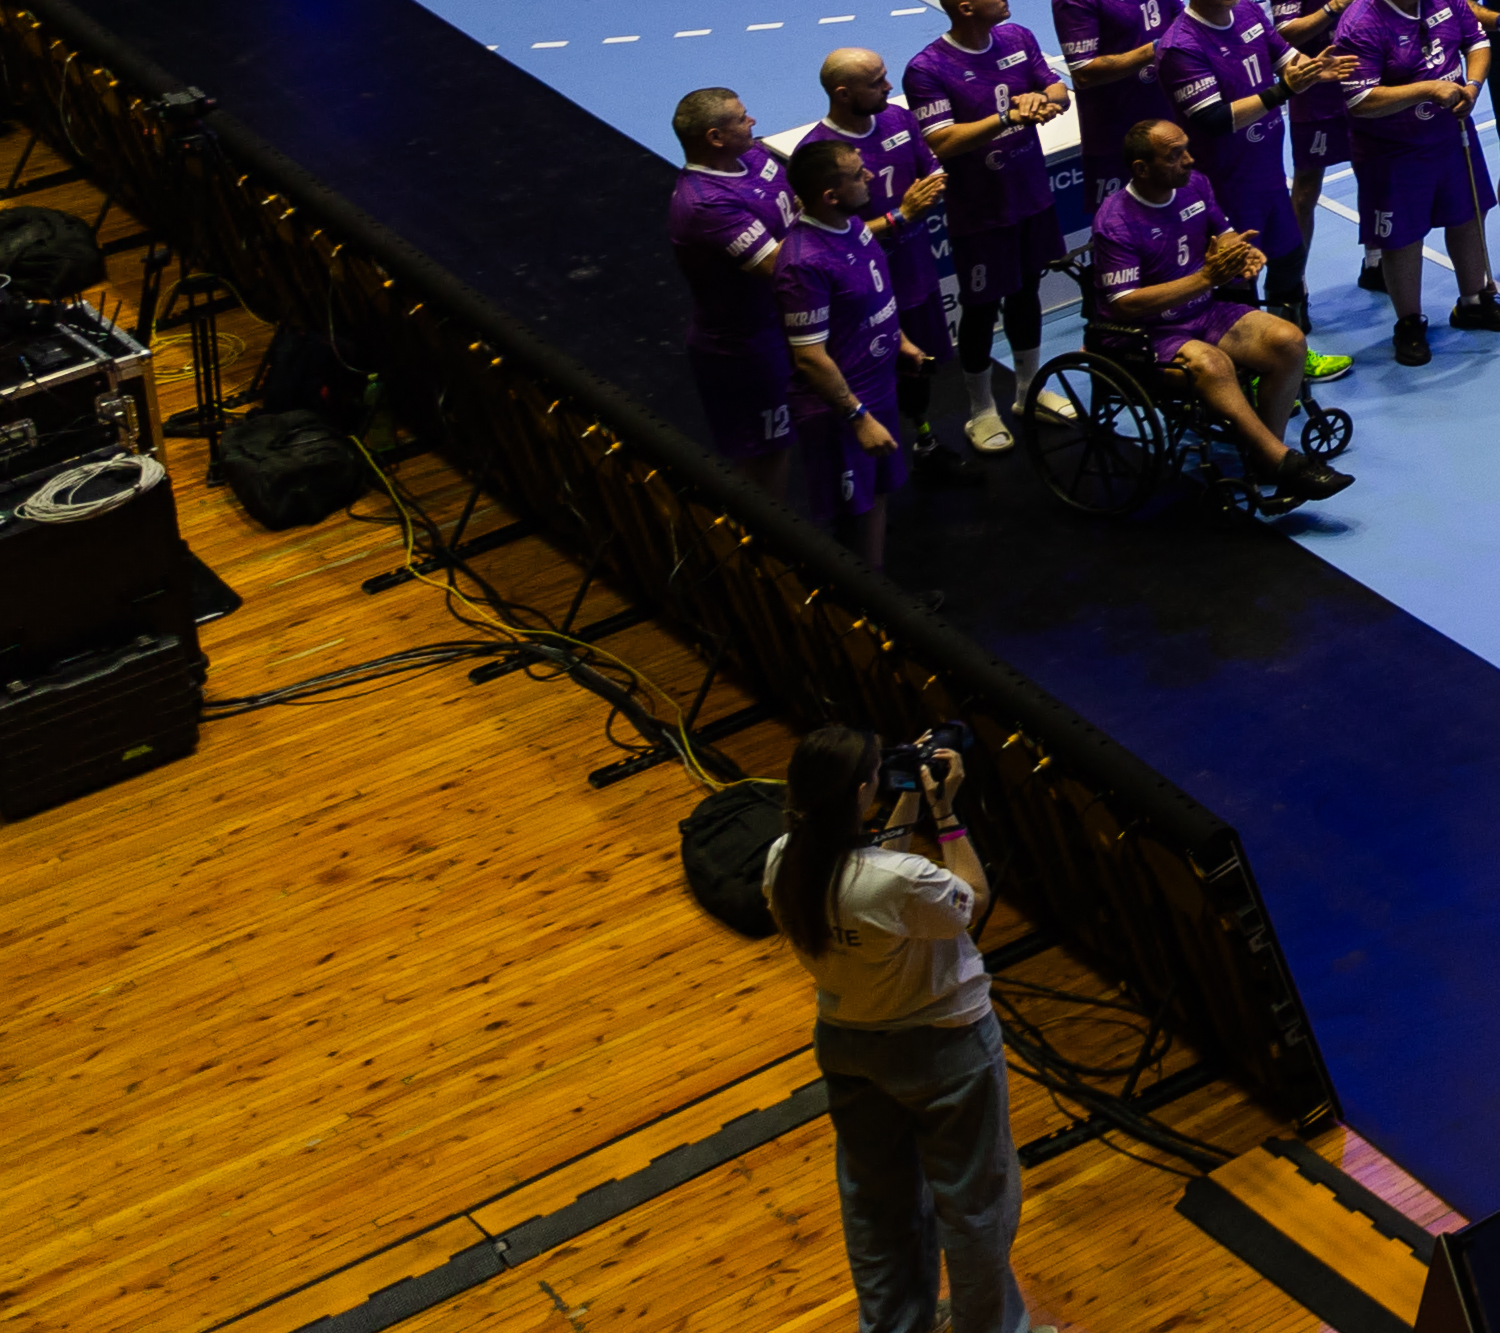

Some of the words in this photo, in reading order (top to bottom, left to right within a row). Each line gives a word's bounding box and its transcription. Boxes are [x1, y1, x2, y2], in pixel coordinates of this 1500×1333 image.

[1140, 0, 1162, 31] 13
[1241, 54, 1264, 87] 11
[993, 83, 1010, 113] 8
[1309, 130, 1327, 156] 4
[878, 165, 895, 199] 7
[1373, 210, 1394, 238] 15
[1176, 234, 1191, 267] 5
[868, 258, 885, 293] 6
[970, 263, 987, 293] 8
[761, 404, 790, 440] 12
